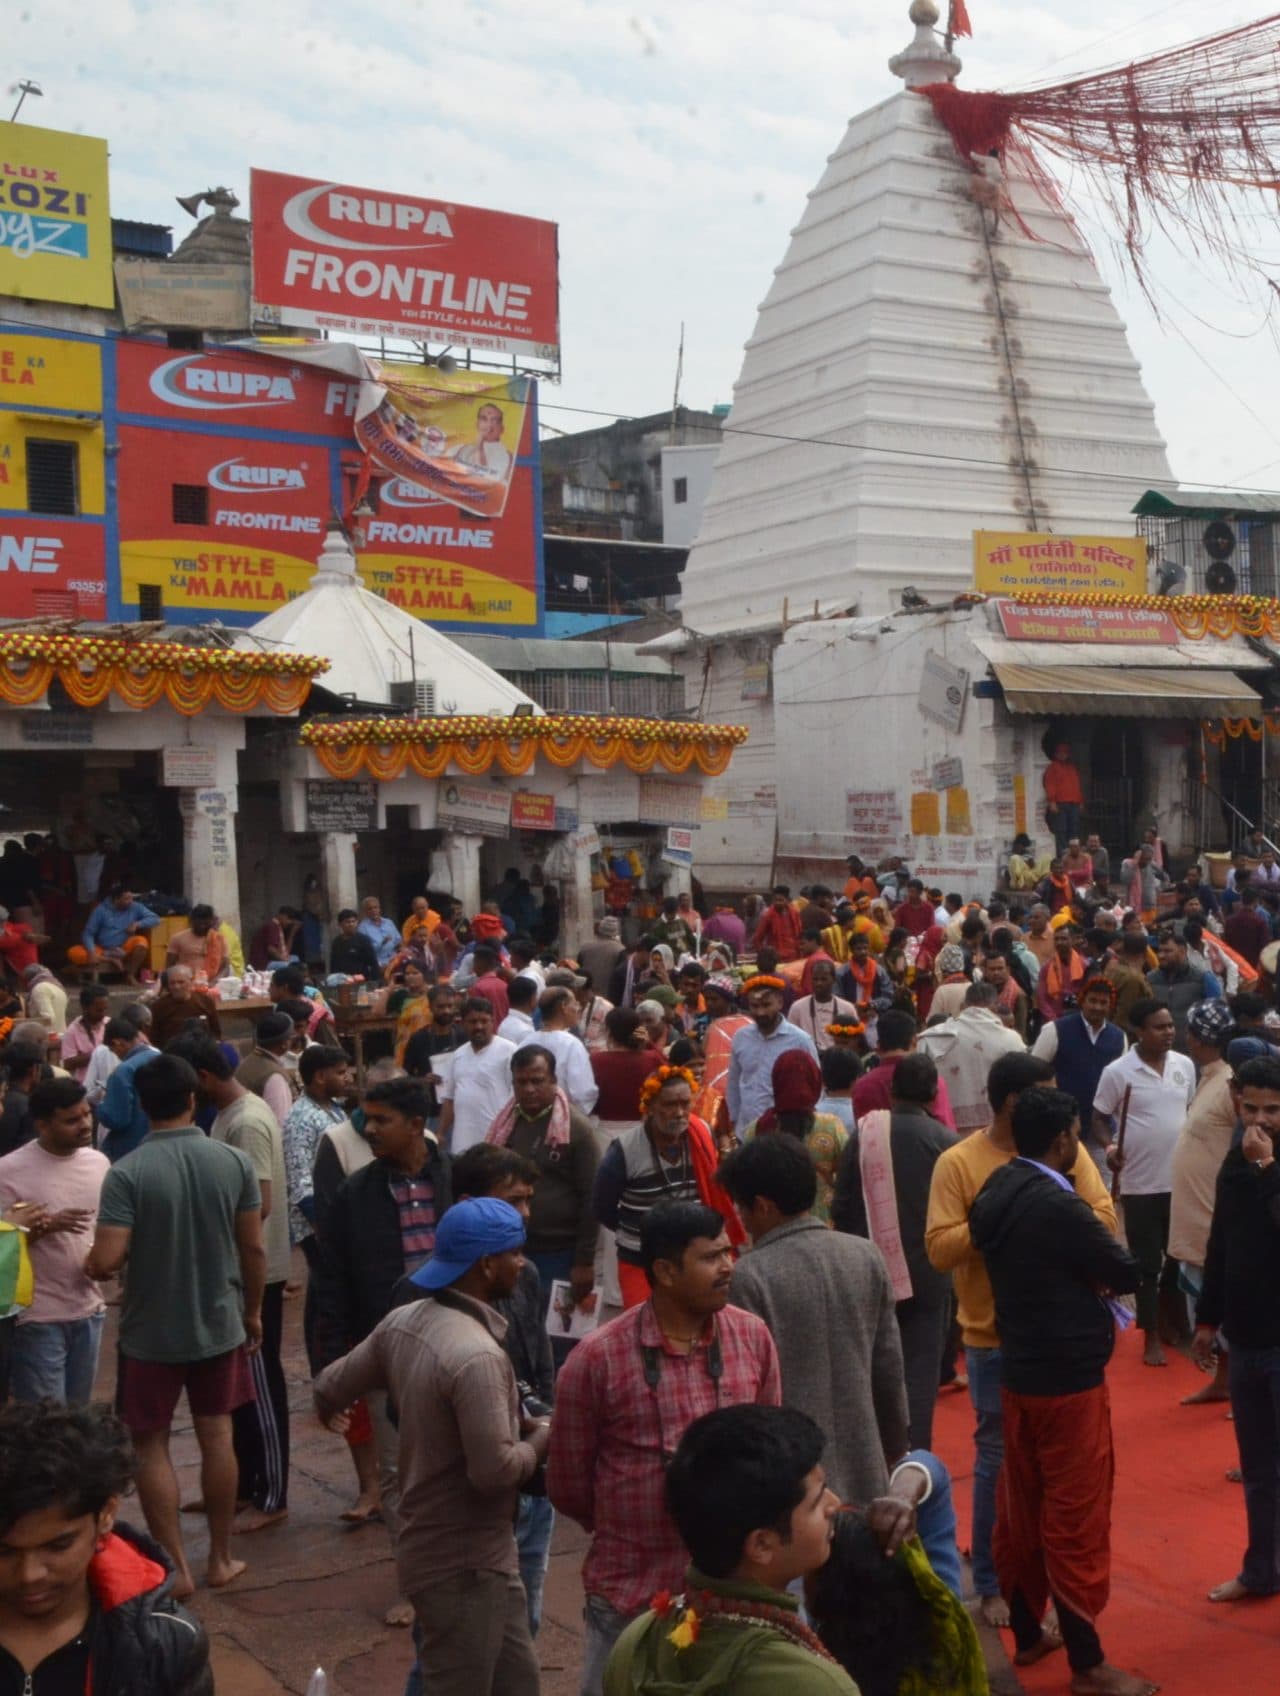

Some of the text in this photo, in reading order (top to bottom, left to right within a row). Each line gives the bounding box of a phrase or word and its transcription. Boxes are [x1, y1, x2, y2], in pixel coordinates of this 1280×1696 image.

[3, 163, 57, 182] LUX
[328, 193, 455, 238] RUPA
[283, 249, 532, 320] FRONTLINE
[420, 309, 455, 323] STYLE
[185, 366, 297, 402] RUPA
[229, 464, 305, 491] RUPA
[215, 510, 320, 534] FRONTLINE
[367, 521, 494, 549] FRONTLINE
[173, 553, 275, 577] YEH STYLE
[1017, 539, 1076, 559] पार्वती
[1082, 545, 1136, 572] मन्दिर
[169, 575, 187, 588] KA
[186, 576, 287, 601] MAMLA
[372, 566, 464, 587] YEH STYLE
[385, 587, 473, 610] MAMLA
